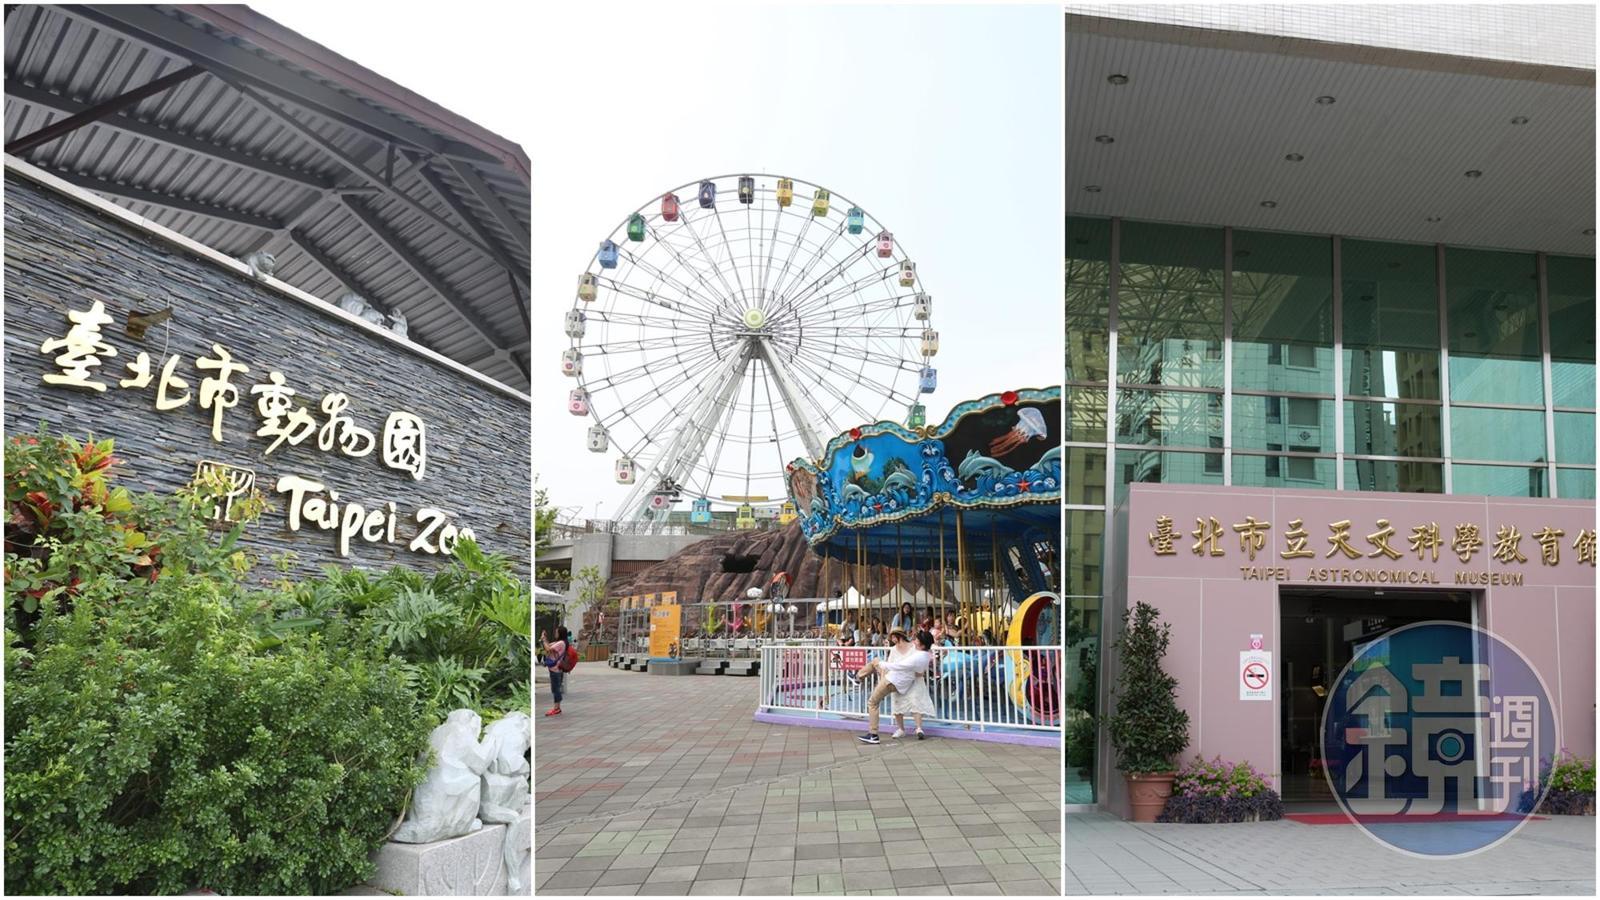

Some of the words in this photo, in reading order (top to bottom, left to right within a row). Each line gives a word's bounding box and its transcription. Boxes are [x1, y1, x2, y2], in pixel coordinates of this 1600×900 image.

[40, 300, 427, 481] 臺北市動物園
[276, 474, 397, 557] Taipei
[1148, 515, 1596, 567] 臺北市立天文科學教育館
[1240, 566, 1290, 581] TAIPEI
[1307, 567, 1440, 585] ASTRONOMICAL
[1454, 571, 1524, 587] MUSEUM
